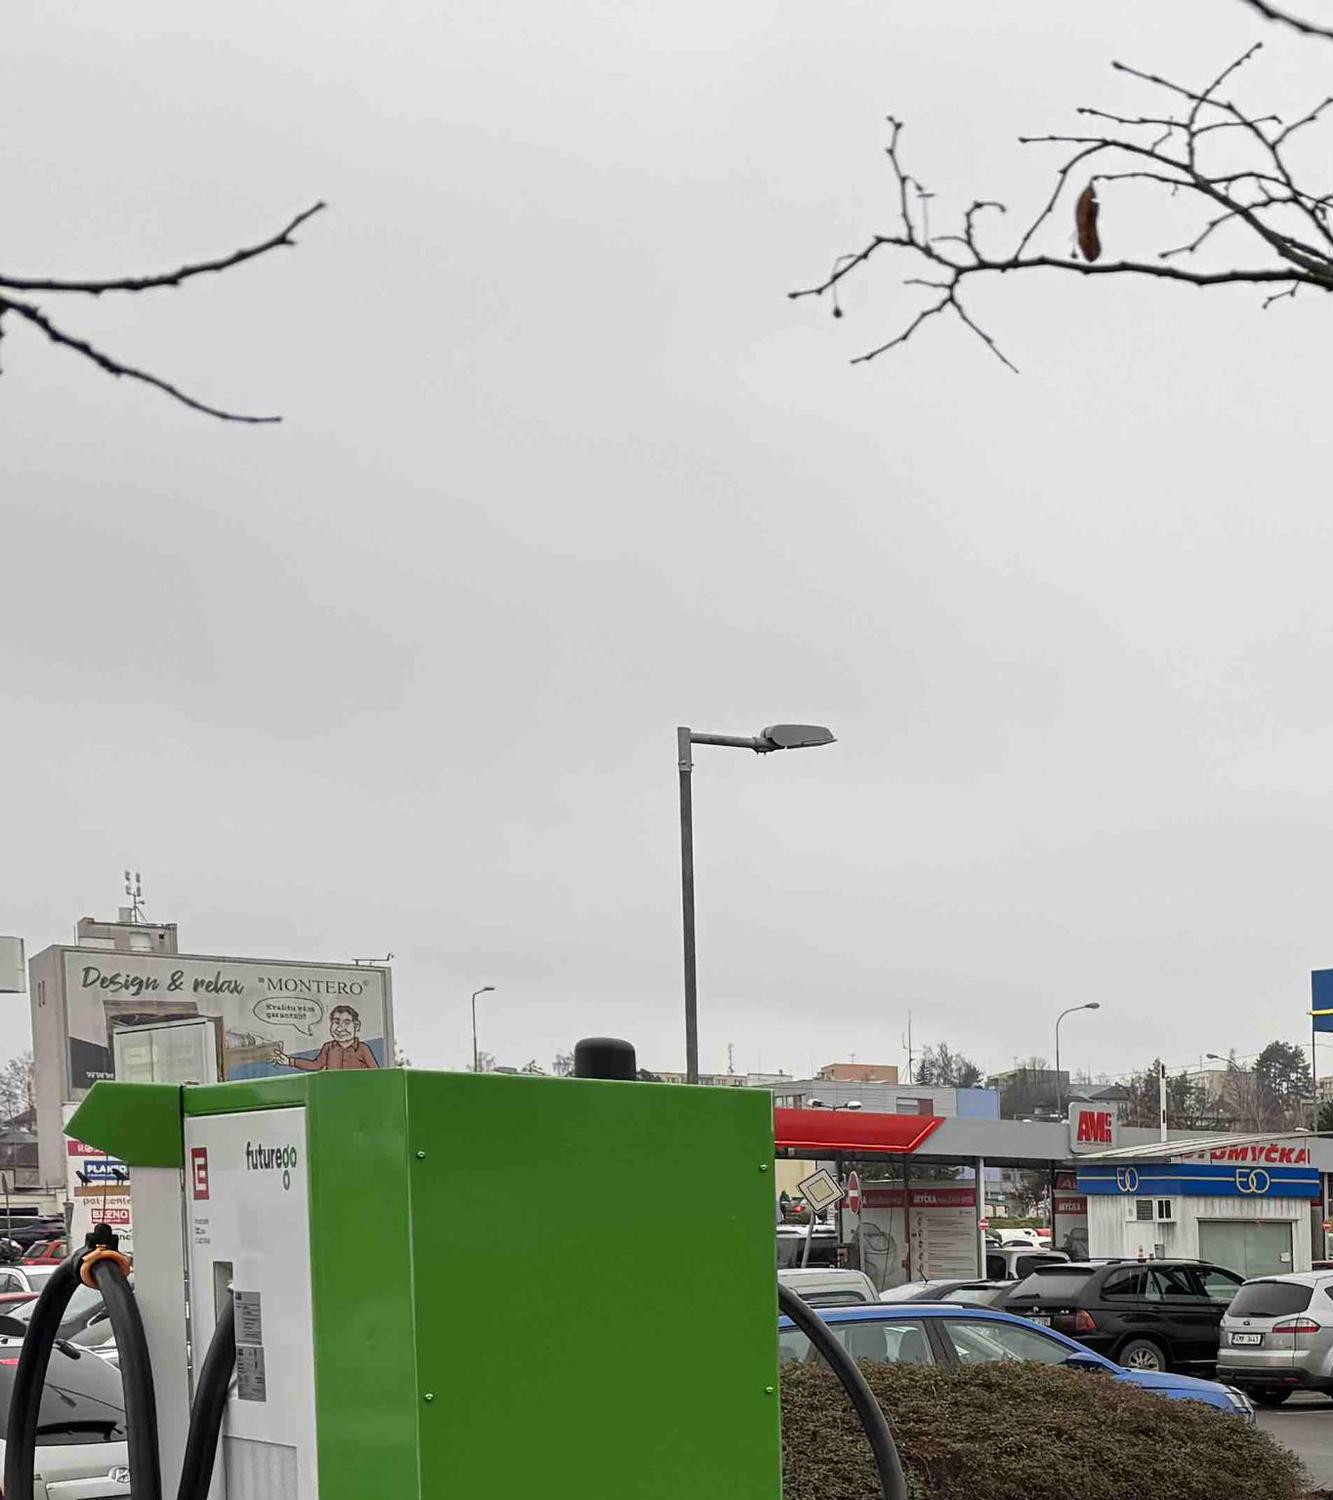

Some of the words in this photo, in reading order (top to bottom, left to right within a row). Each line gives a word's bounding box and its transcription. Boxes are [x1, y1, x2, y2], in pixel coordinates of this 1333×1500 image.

[82, 966, 160, 997] Design
[166, 969, 185, 992] &
[192, 971, 245, 996] relax
[245, 1140, 297, 1191] futurego
